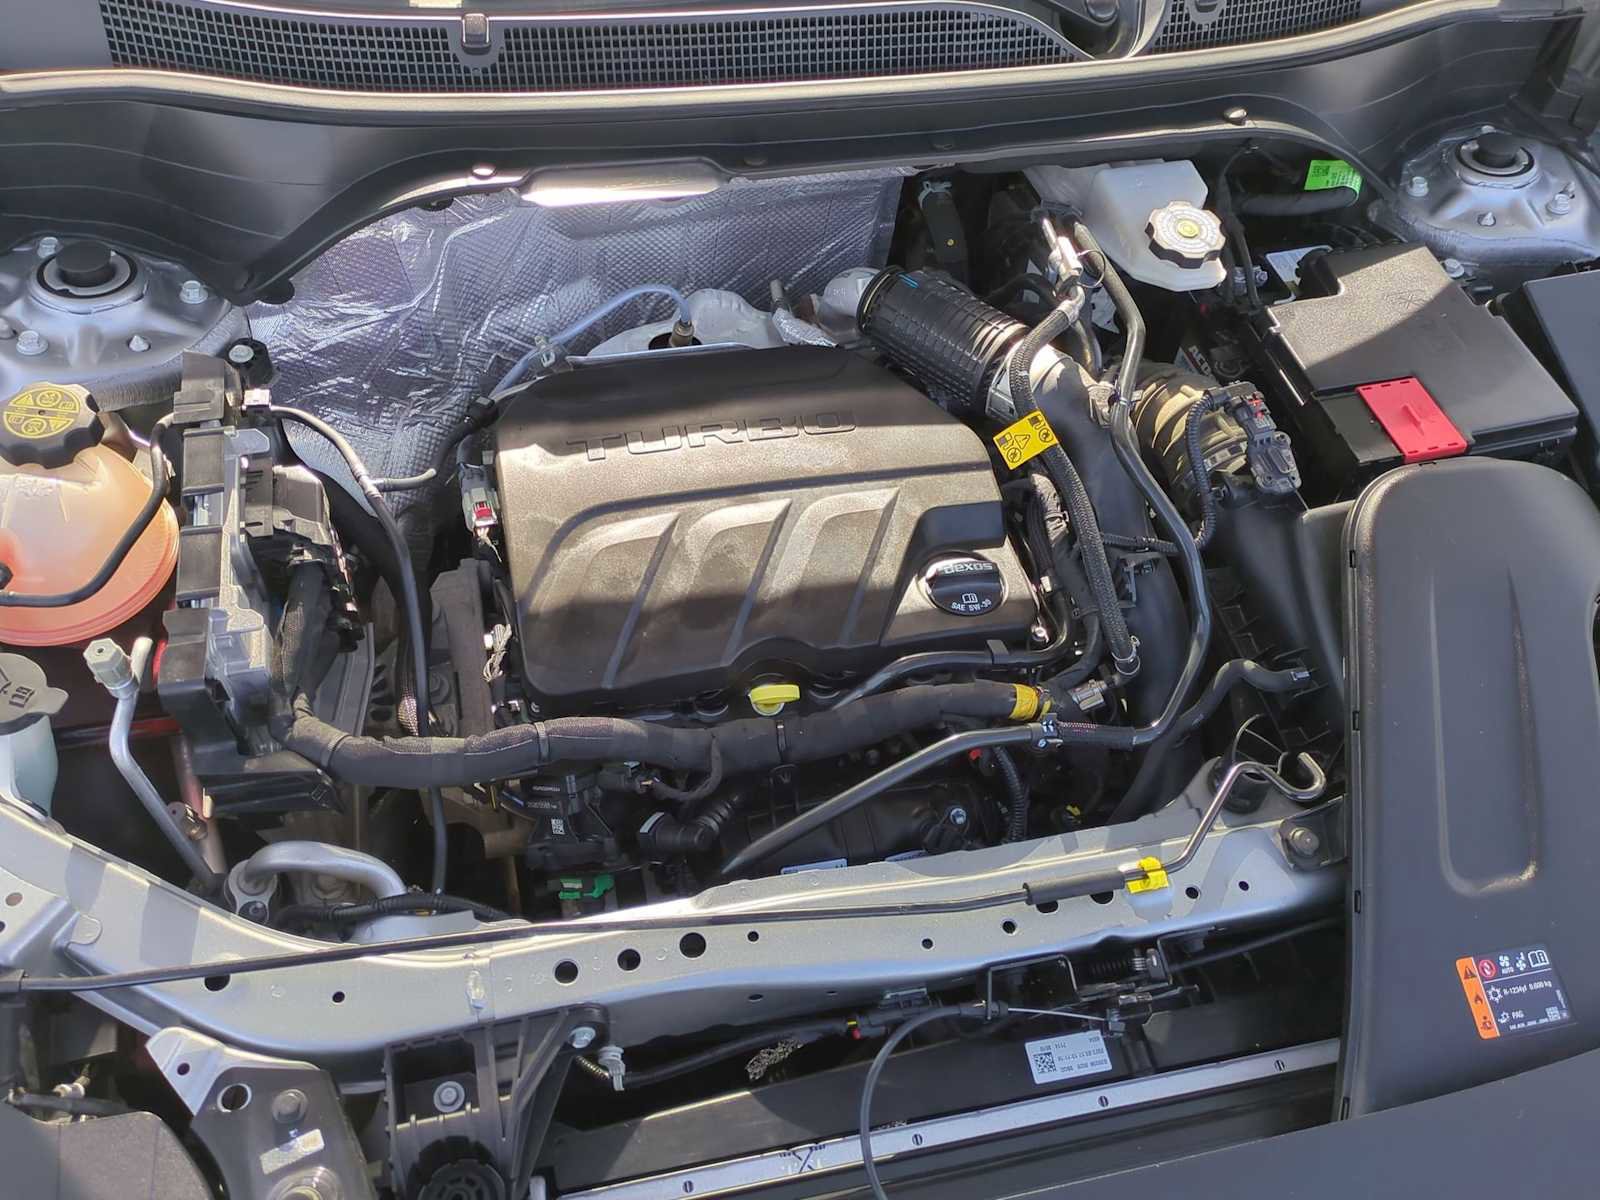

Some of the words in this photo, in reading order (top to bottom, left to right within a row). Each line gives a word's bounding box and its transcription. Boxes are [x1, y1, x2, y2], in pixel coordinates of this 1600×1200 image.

[566, 411, 857, 462] TURBO
[943, 562, 993, 574] dexos
[951, 602, 966, 611] SAE
[1501, 966, 1514, 975] AUTO
